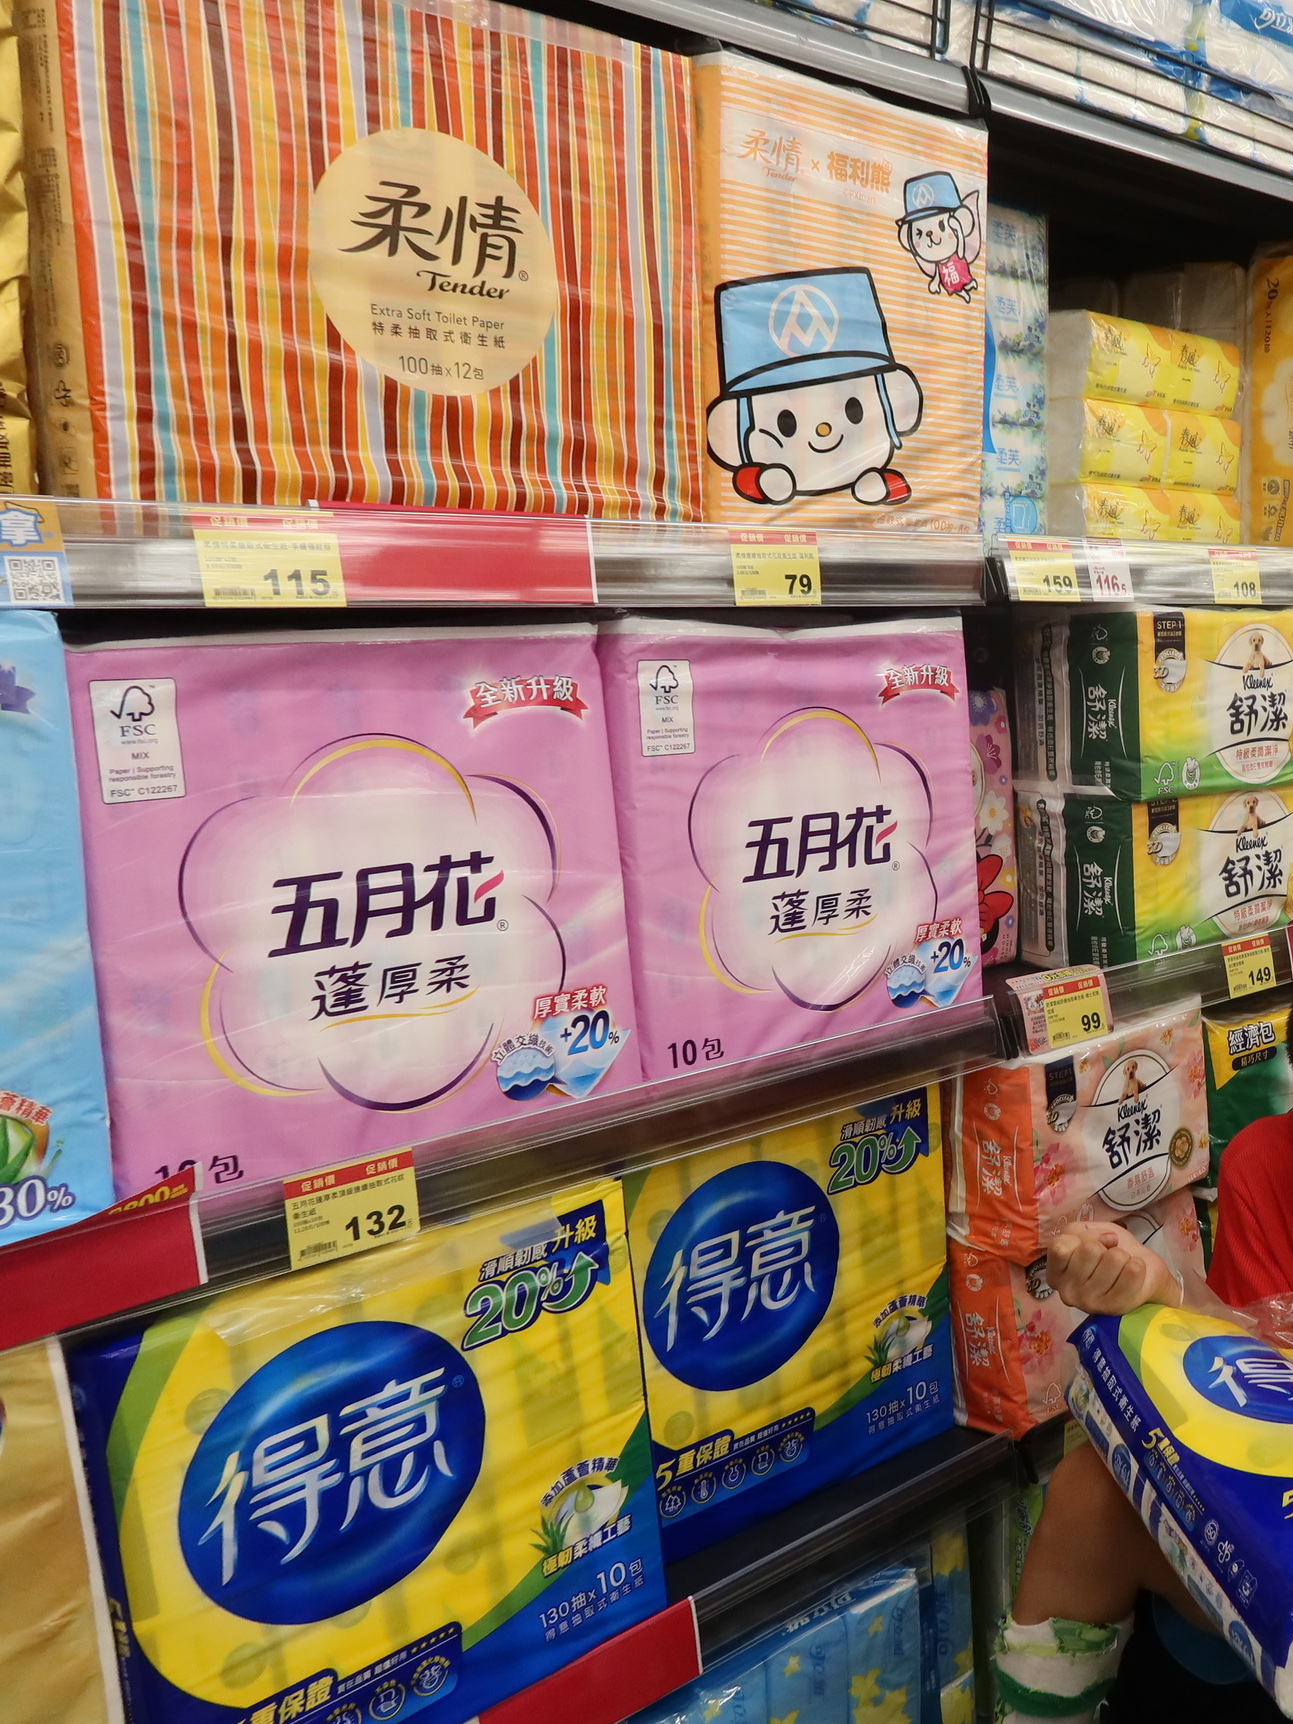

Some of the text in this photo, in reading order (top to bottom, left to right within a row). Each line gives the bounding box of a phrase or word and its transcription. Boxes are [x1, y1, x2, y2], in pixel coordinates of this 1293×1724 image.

[736, 128, 893, 193] 柔情 福利熊
[763, 167, 798, 183] Tender
[338, 180, 526, 282] 柔情
[416, 269, 511, 300] Tender
[942, 262, 960, 285] 福
[370, 303, 505, 333] Extra Soft Toilet Paper
[371, 320, 506, 349] 特柔抽取式衛生紙
[263, 569, 330, 596] 115
[784, 574, 812, 595] 79
[1043, 574, 1073, 593] 159
[1233, 580, 1256, 598] 108
[475, 675, 576, 709] 全新升級
[888, 664, 949, 690] 全新升級
[1243, 675, 1273, 691] Kleenex
[655, 695, 679, 705] FSC
[1087, 684, 1108, 741] 舒潔
[1108, 698, 1117, 728] Kleenex
[1226, 691, 1288, 736] 舒潔
[120, 724, 157, 737] FSC
[131, 752, 150, 760] MIX
[664, 743, 690, 751] C122267
[1235, 745, 1279, 760] 特級柔潤潔淨
[109, 771, 176, 782] responsible forestry
[136, 765, 174, 774] Supporting
[138, 785, 178, 795] C122267
[1157, 786, 1173, 794] FSC
[742, 805, 897, 883] 五月花
[1235, 835, 1269, 853] Kleenex
[1219, 848, 1284, 898] 舒潔
[1083, 862, 1104, 916] 舒潔
[1103, 876, 1112, 904] Kleenex
[268, 851, 504, 958] 五月花
[768, 888, 872, 936] 蓬厚柔
[1233, 900, 1274, 921] 特級柔潤潔淨
[915, 918, 963, 942] 厚實柔軟
[1228, 938, 1265, 954] 促銷價 促銷價
[308, 955, 471, 1021] 蓬厚柔
[1047, 979, 1094, 997] 促銷價 促銷價
[1249, 967, 1272, 986] 149
[534, 985, 607, 1019] 厚實柔軟
[1081, 1013, 1101, 1032] 99
[493, 1032, 554, 1062] 立體交織技術
[667, 1037, 725, 1068] 10包
[1228, 1021, 1276, 1055] 經濟包
[1236, 1049, 1273, 1071] 精巧尺寸
[841, 1097, 922, 1141] 滑順韌感 升級
[1117, 1100, 1148, 1122] Kleenex
[1102, 1109, 1162, 1170] 舒潔
[301, 1158, 398, 1192] 促銷價 促銷價
[828, 1131, 898, 1194] 20%
[982, 1138, 1003, 1199] 舒潔
[1003, 1155, 1013, 1187] Kleenex
[345, 1204, 406, 1241] 132
[480, 1214, 597, 1281] 滑順韌感 升級
[654, 1205, 818, 1353] 得意
[463, 1261, 563, 1350] 20%
[965, 1312, 990, 1368] 舒潔
[1092, 1347, 1142, 1433] 得意抽取式衛生紙
[198, 1366, 453, 1586] 得意
[655, 1435, 732, 1491] 5重保證
[540, 1456, 619, 1507] 添加蘆薈精華
[545, 1575, 644, 1642] 得意抽取式衛生紙
